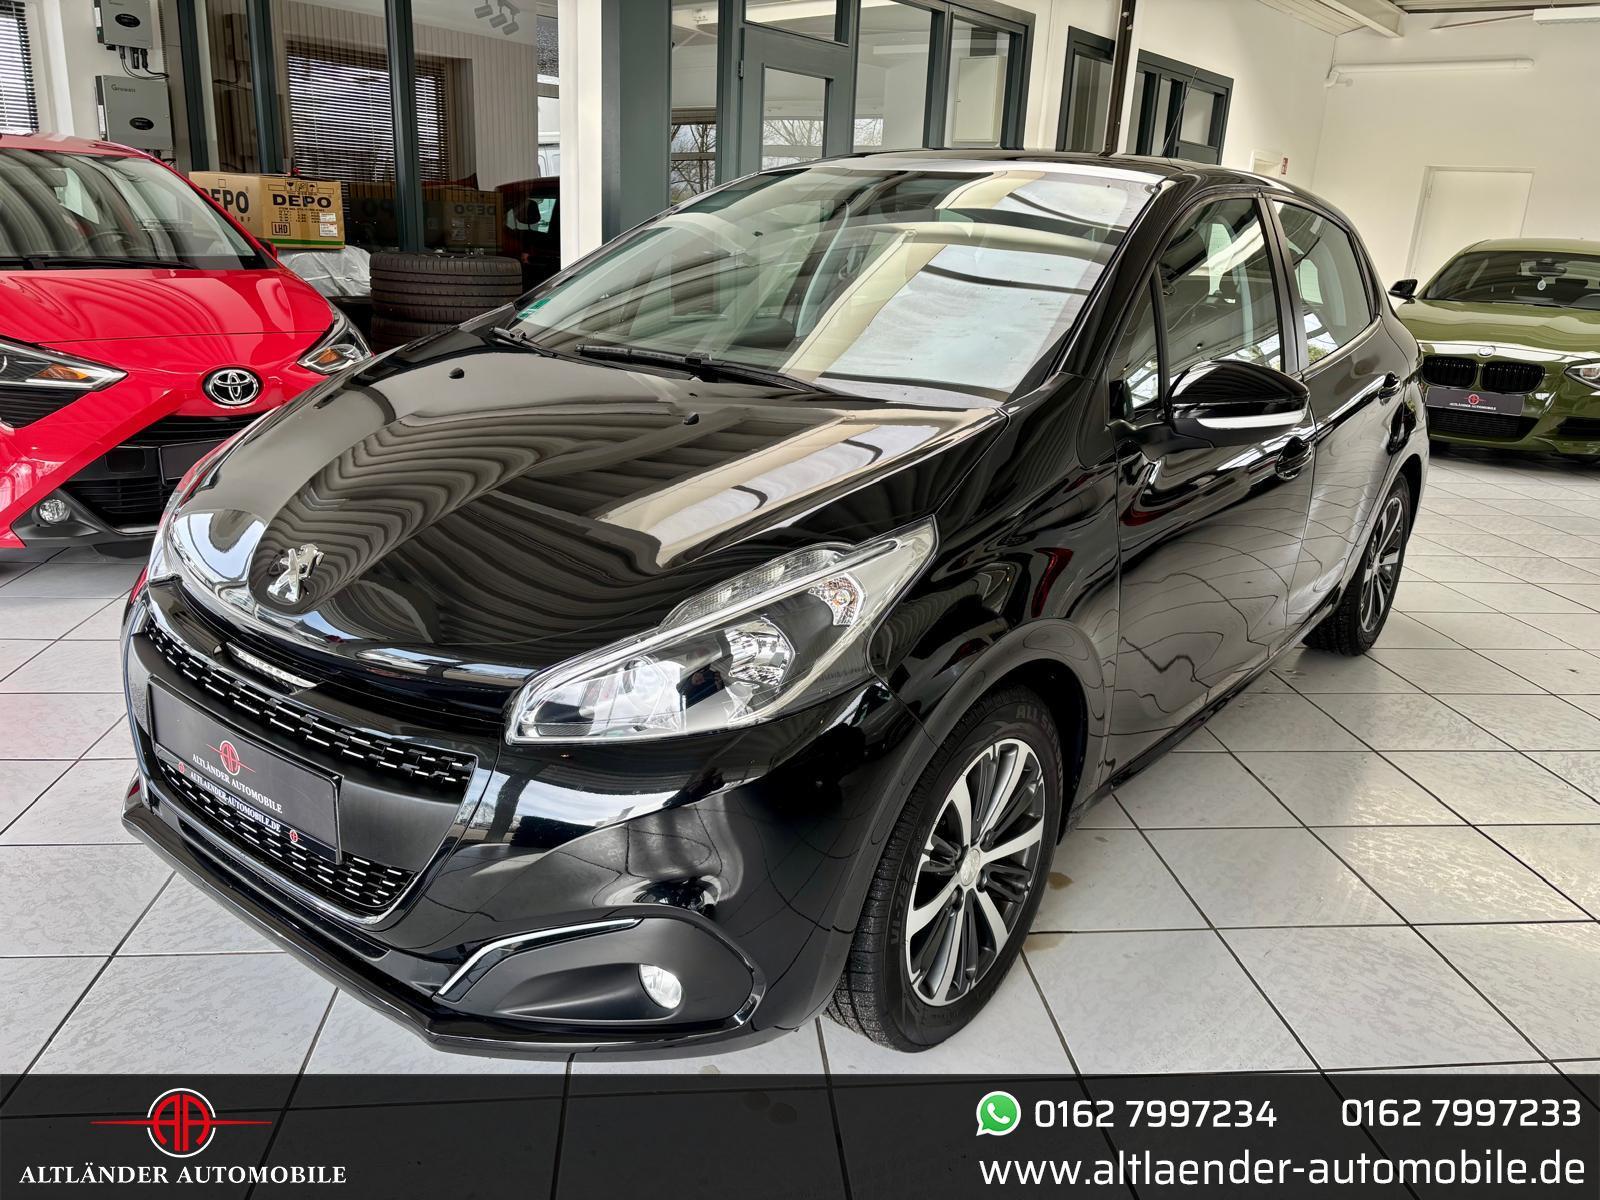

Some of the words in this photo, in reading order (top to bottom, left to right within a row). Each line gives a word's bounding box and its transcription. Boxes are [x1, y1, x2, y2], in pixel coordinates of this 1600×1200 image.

[272, 193, 332, 209] DEPO
[274, 223, 288, 234] LHD
[1015, 704, 1039, 722] ALL
[190, 771, 282, 832] ALTLAENDER-AUTOMOBILE.DE
[231, 778, 283, 814] AUTOMOBILE
